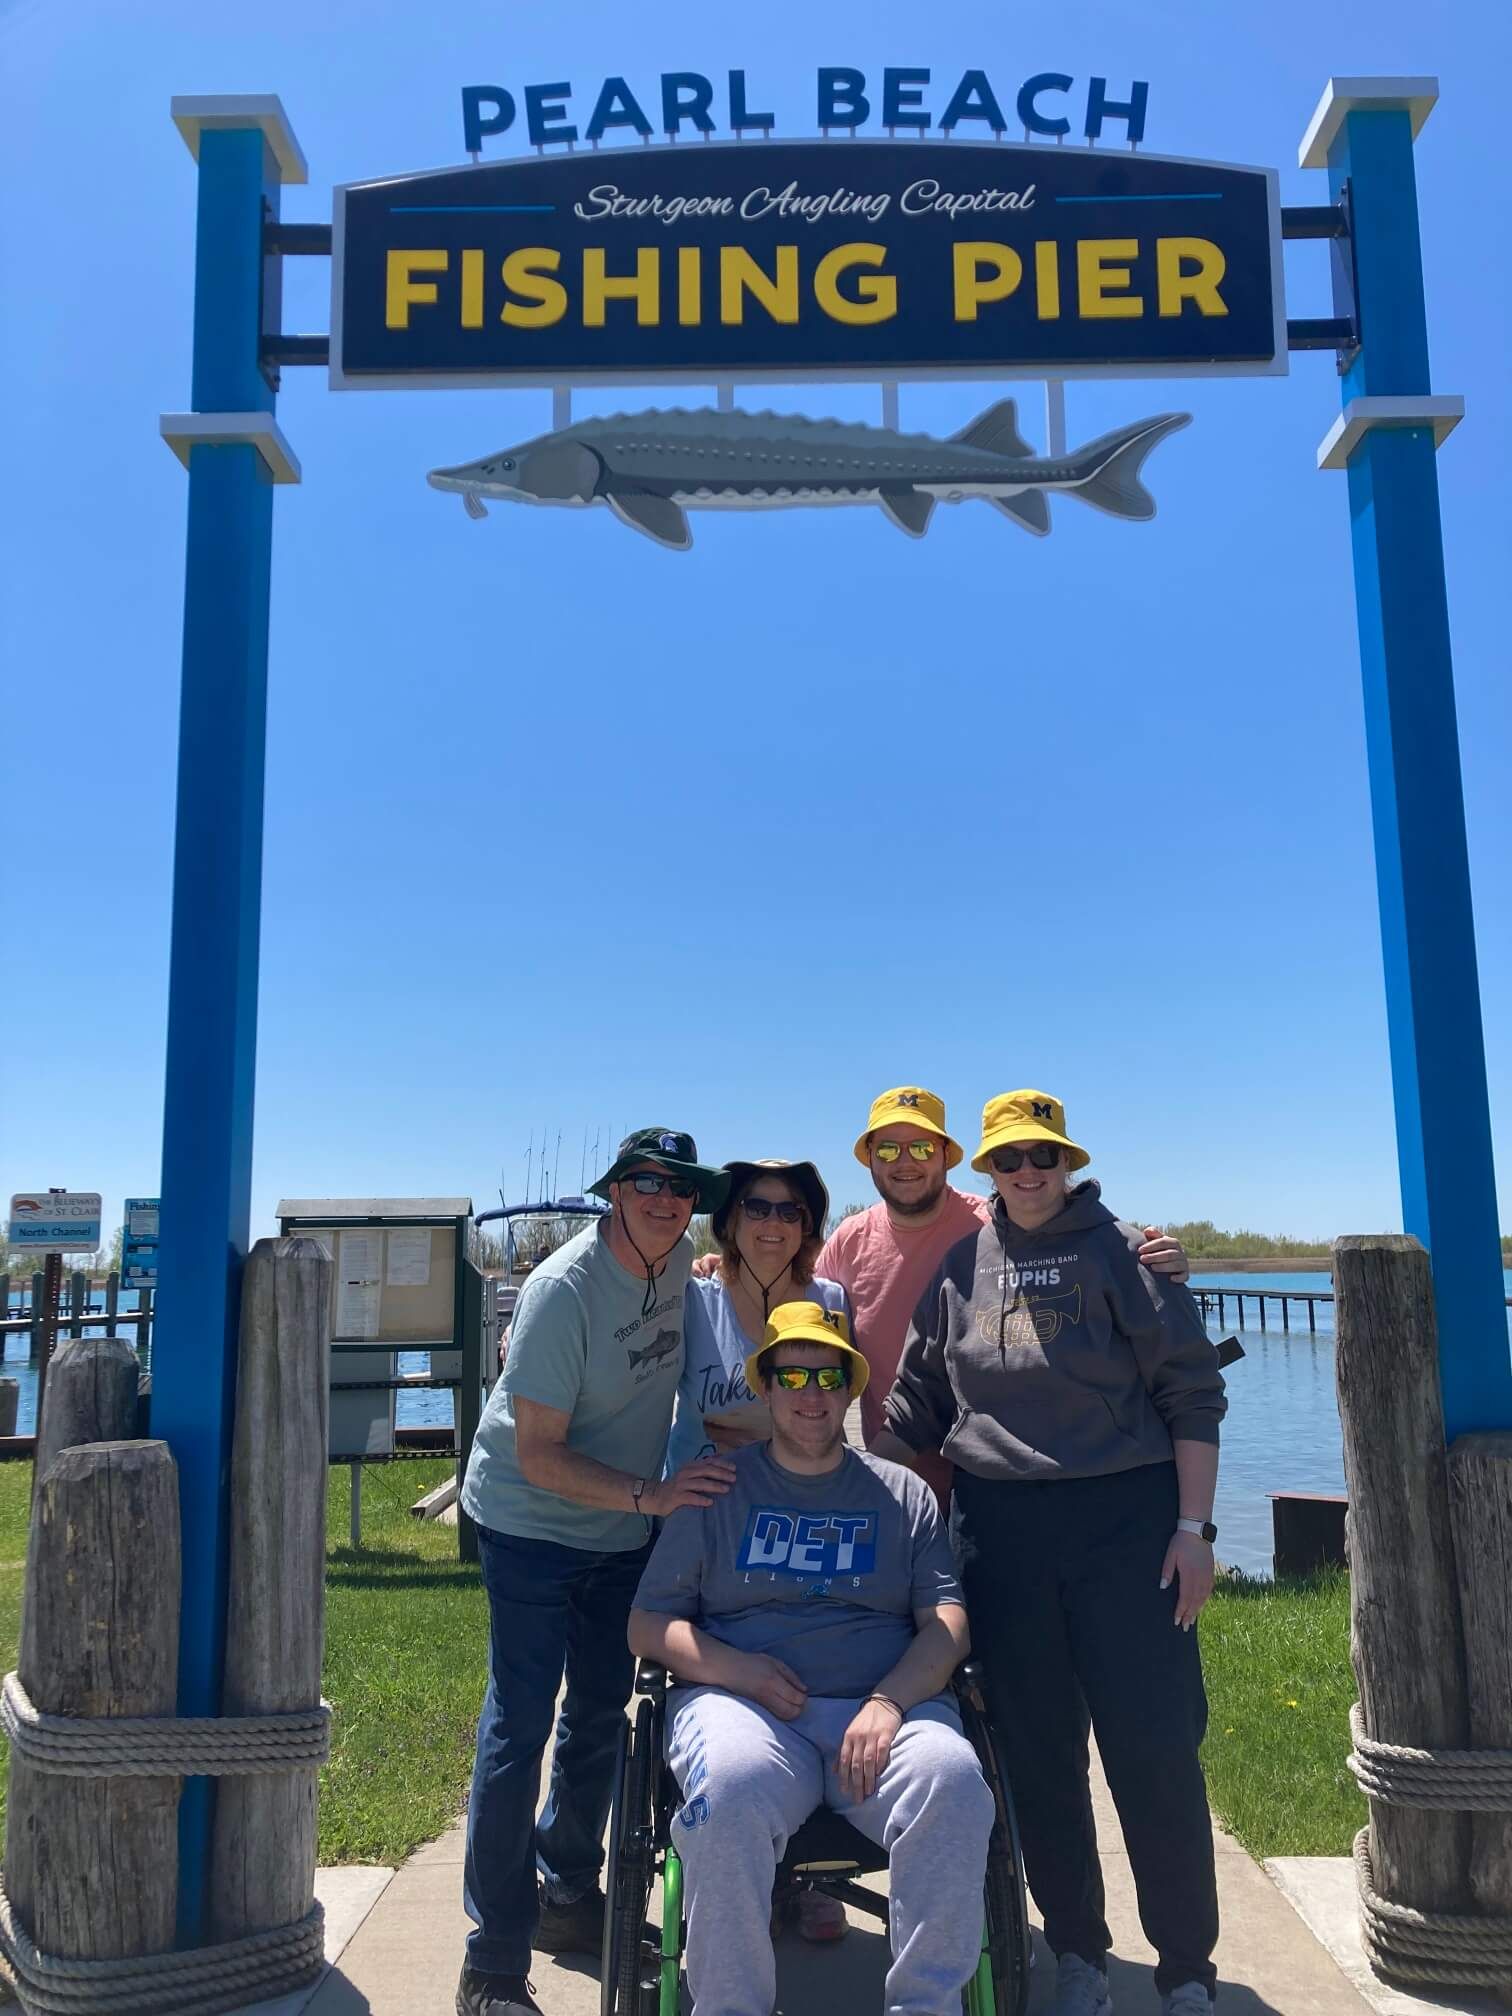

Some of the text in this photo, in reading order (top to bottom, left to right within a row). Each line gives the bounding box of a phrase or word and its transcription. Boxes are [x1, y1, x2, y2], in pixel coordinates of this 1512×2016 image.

[461, 66, 1149, 152] PEARL BEACH
[574, 178, 1036, 224] Sturgeon Angling Capital
[386, 236, 1229, 329] FISHING PIER
[898, 1094, 919, 1107] M
[1031, 1102, 1053, 1120] M
[19, 1226, 91, 1237] North Channel
[1057, 1254, 1079, 1264] BAND
[997, 1267, 1061, 1290] EUPHS
[746, 1511, 869, 1572] DET
